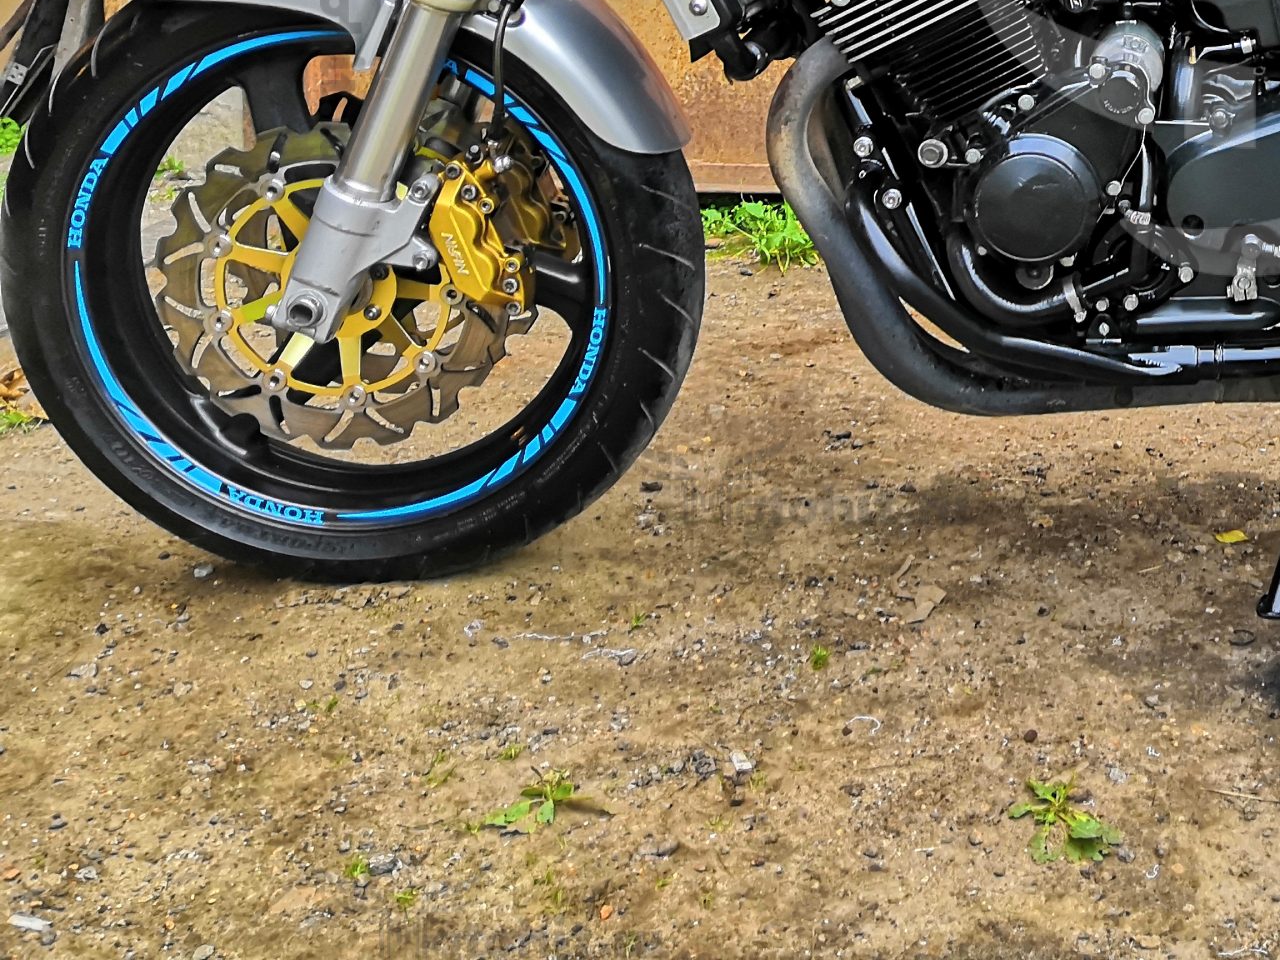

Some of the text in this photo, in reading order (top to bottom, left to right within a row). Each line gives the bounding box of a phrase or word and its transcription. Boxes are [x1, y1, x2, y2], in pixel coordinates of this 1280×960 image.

[67, 157, 110, 248] HONDA
[570, 307, 606, 395] HONDA
[226, 485, 326, 526] HONDA
